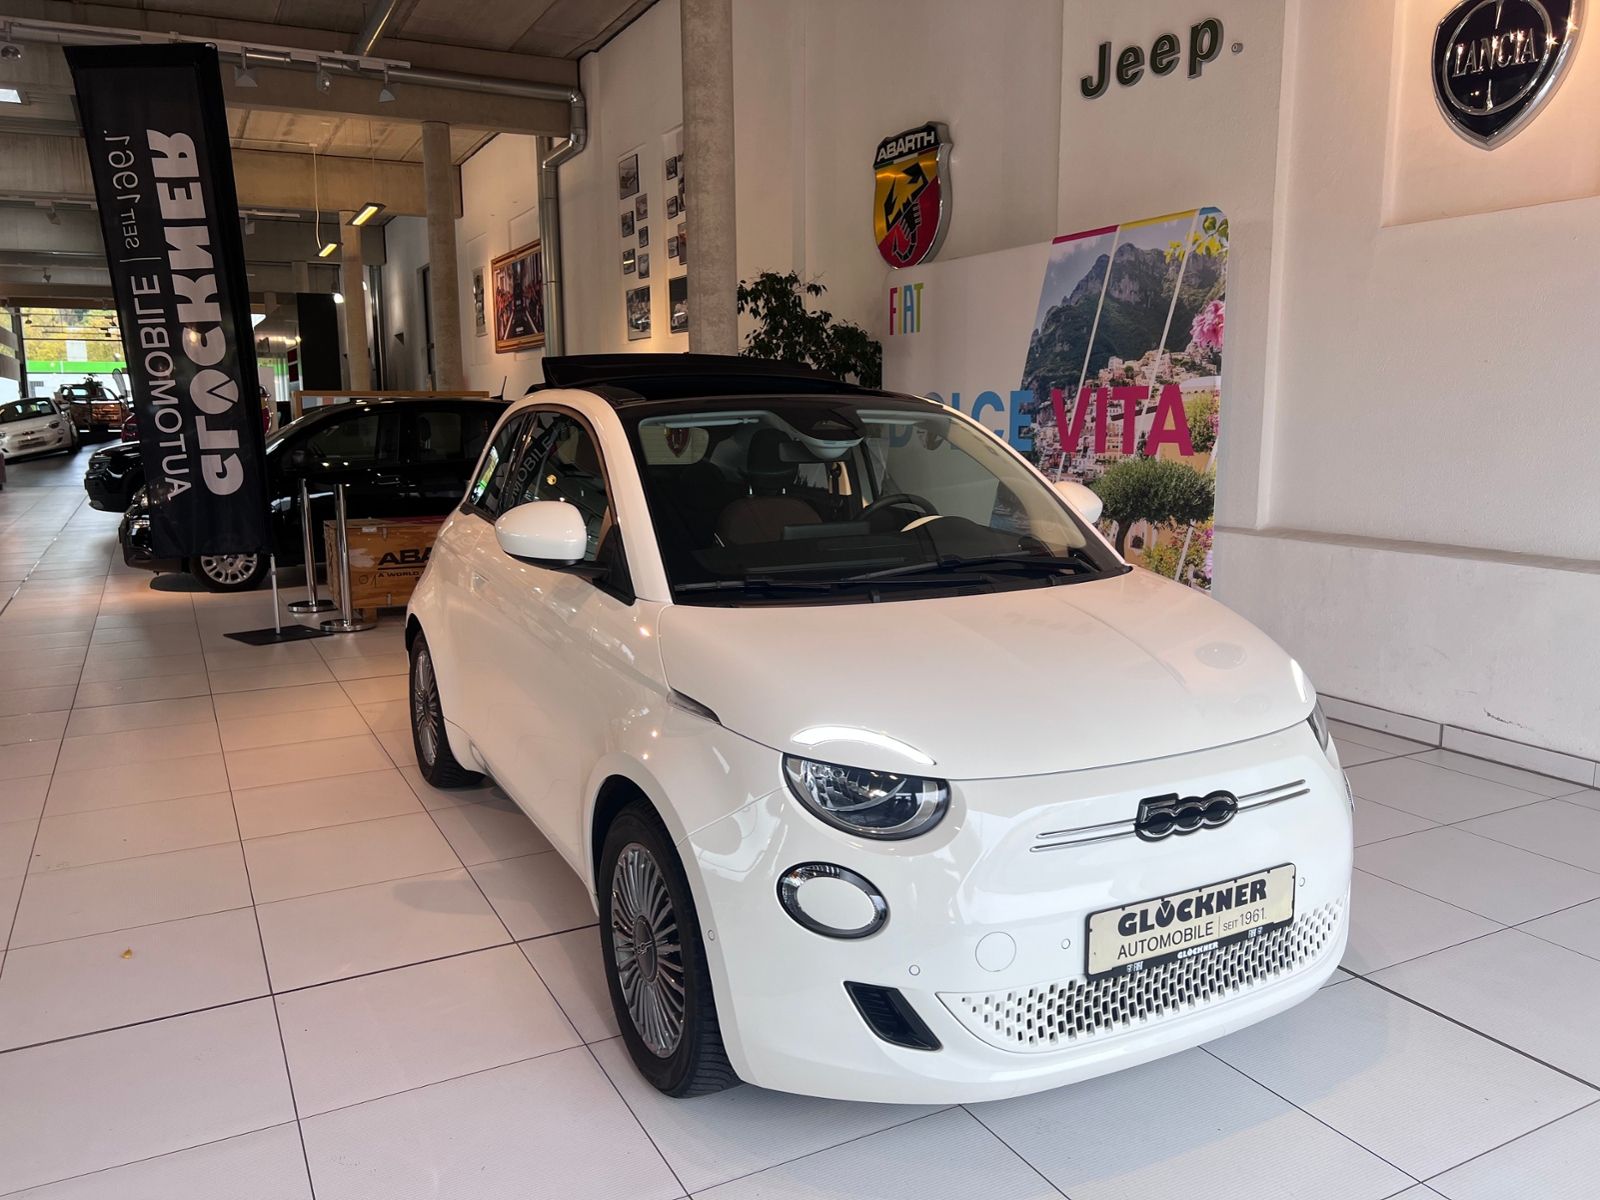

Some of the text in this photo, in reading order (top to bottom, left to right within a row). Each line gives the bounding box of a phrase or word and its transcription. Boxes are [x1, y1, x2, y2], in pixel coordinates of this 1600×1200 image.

[1080, 17, 1225, 100] Jeep
[1451, 27, 1540, 78] LANCIA
[876, 130, 936, 163] ABARTH
[889, 282, 924, 335] FIAT
[1049, 383, 1194, 456] VITA
[1134, 789, 1239, 842] 500
[1117, 921, 1214, 960] AUTOMOBILE
[1223, 919, 1239, 931] SEIT
